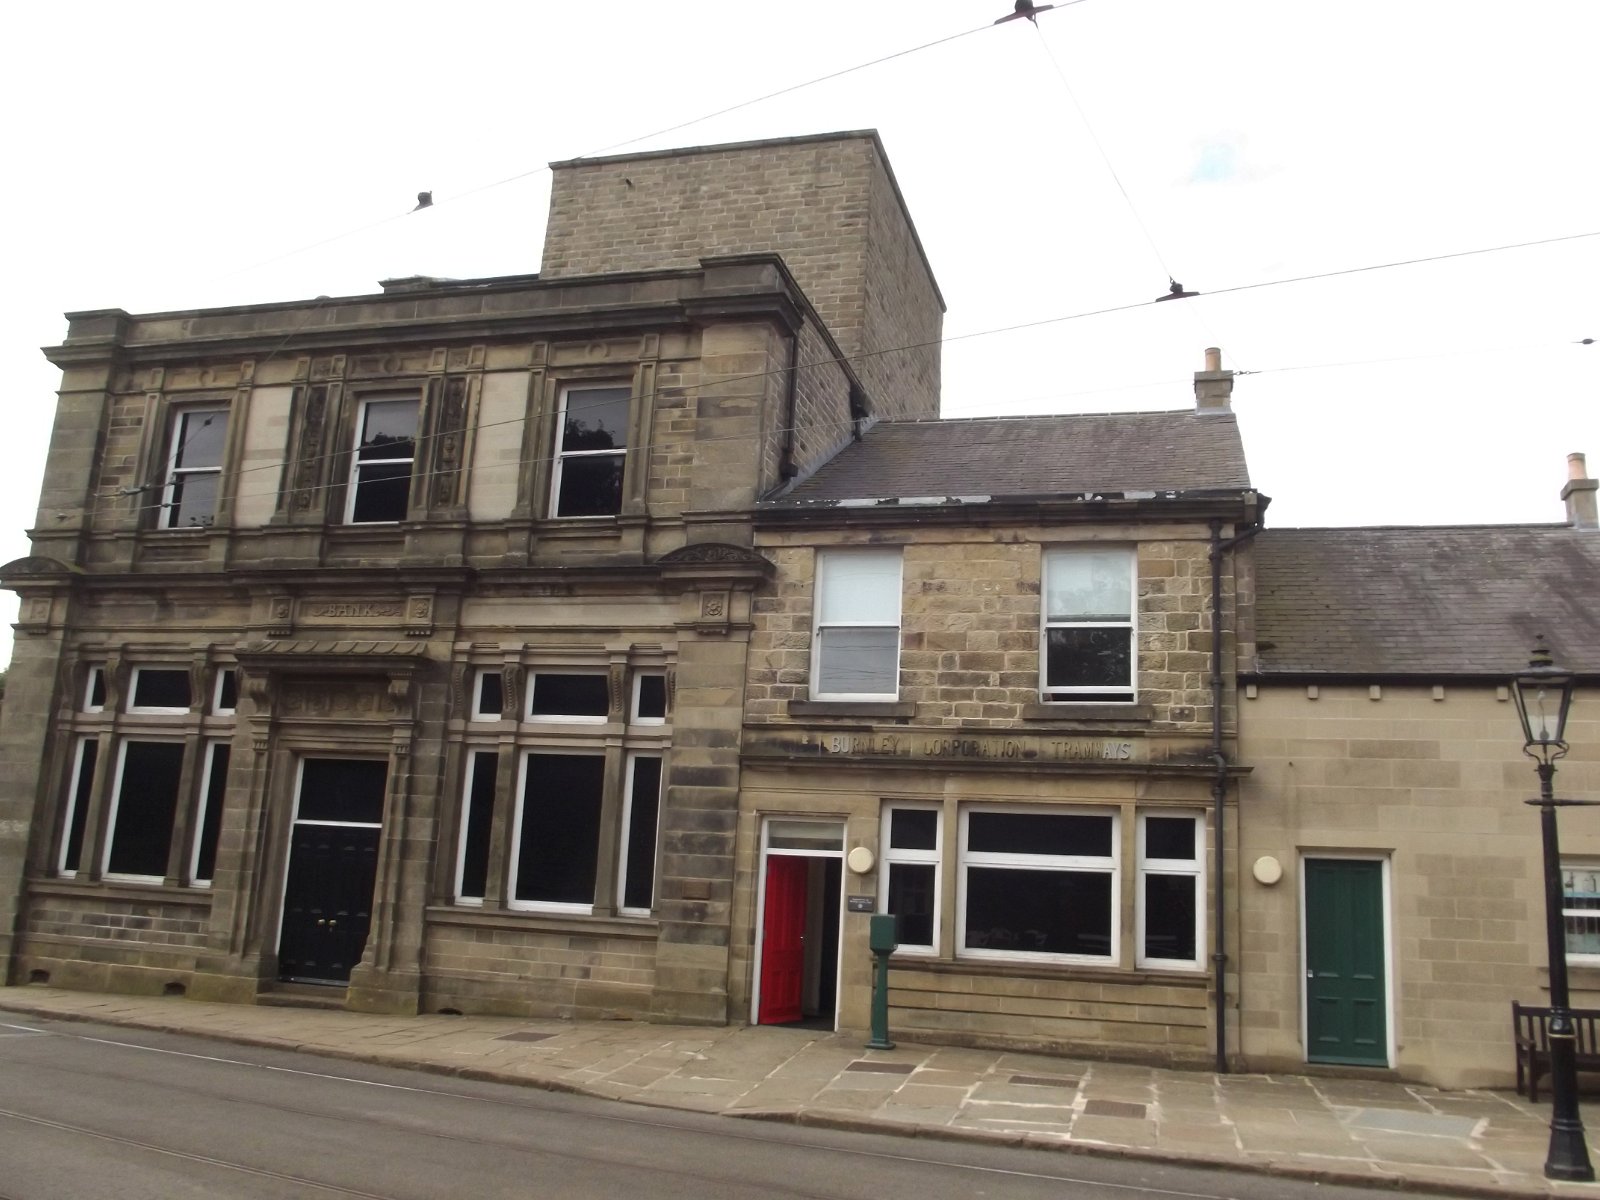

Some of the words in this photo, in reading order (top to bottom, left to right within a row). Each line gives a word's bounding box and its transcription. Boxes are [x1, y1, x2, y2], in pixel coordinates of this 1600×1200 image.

[328, 603, 374, 617] BANK
[831, 735, 900, 755] BURNLEY
[924, 738, 1026, 760] CORPORATION
[1051, 741, 1131, 761] TRAMWAYS
